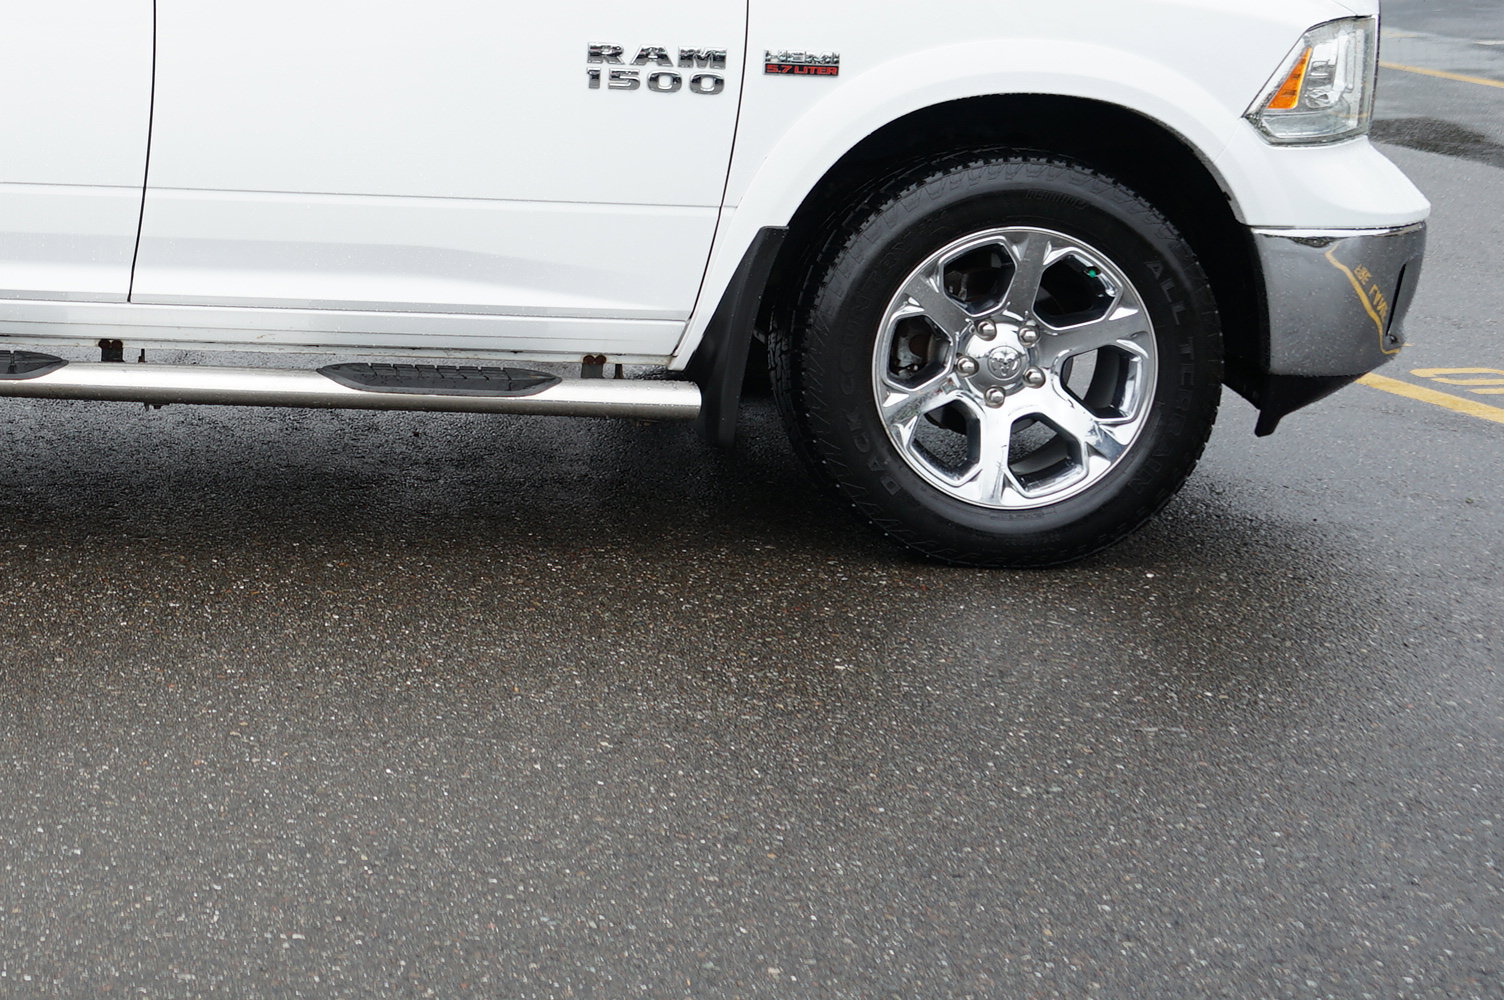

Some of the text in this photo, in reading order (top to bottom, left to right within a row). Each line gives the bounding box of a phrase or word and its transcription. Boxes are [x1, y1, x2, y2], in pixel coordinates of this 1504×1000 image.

[587, 42, 727, 69] RAM
[586, 67, 725, 95] 1500
[766, 64, 838, 75] 5.7 LITER
[1144, 260, 1186, 325] ALL
